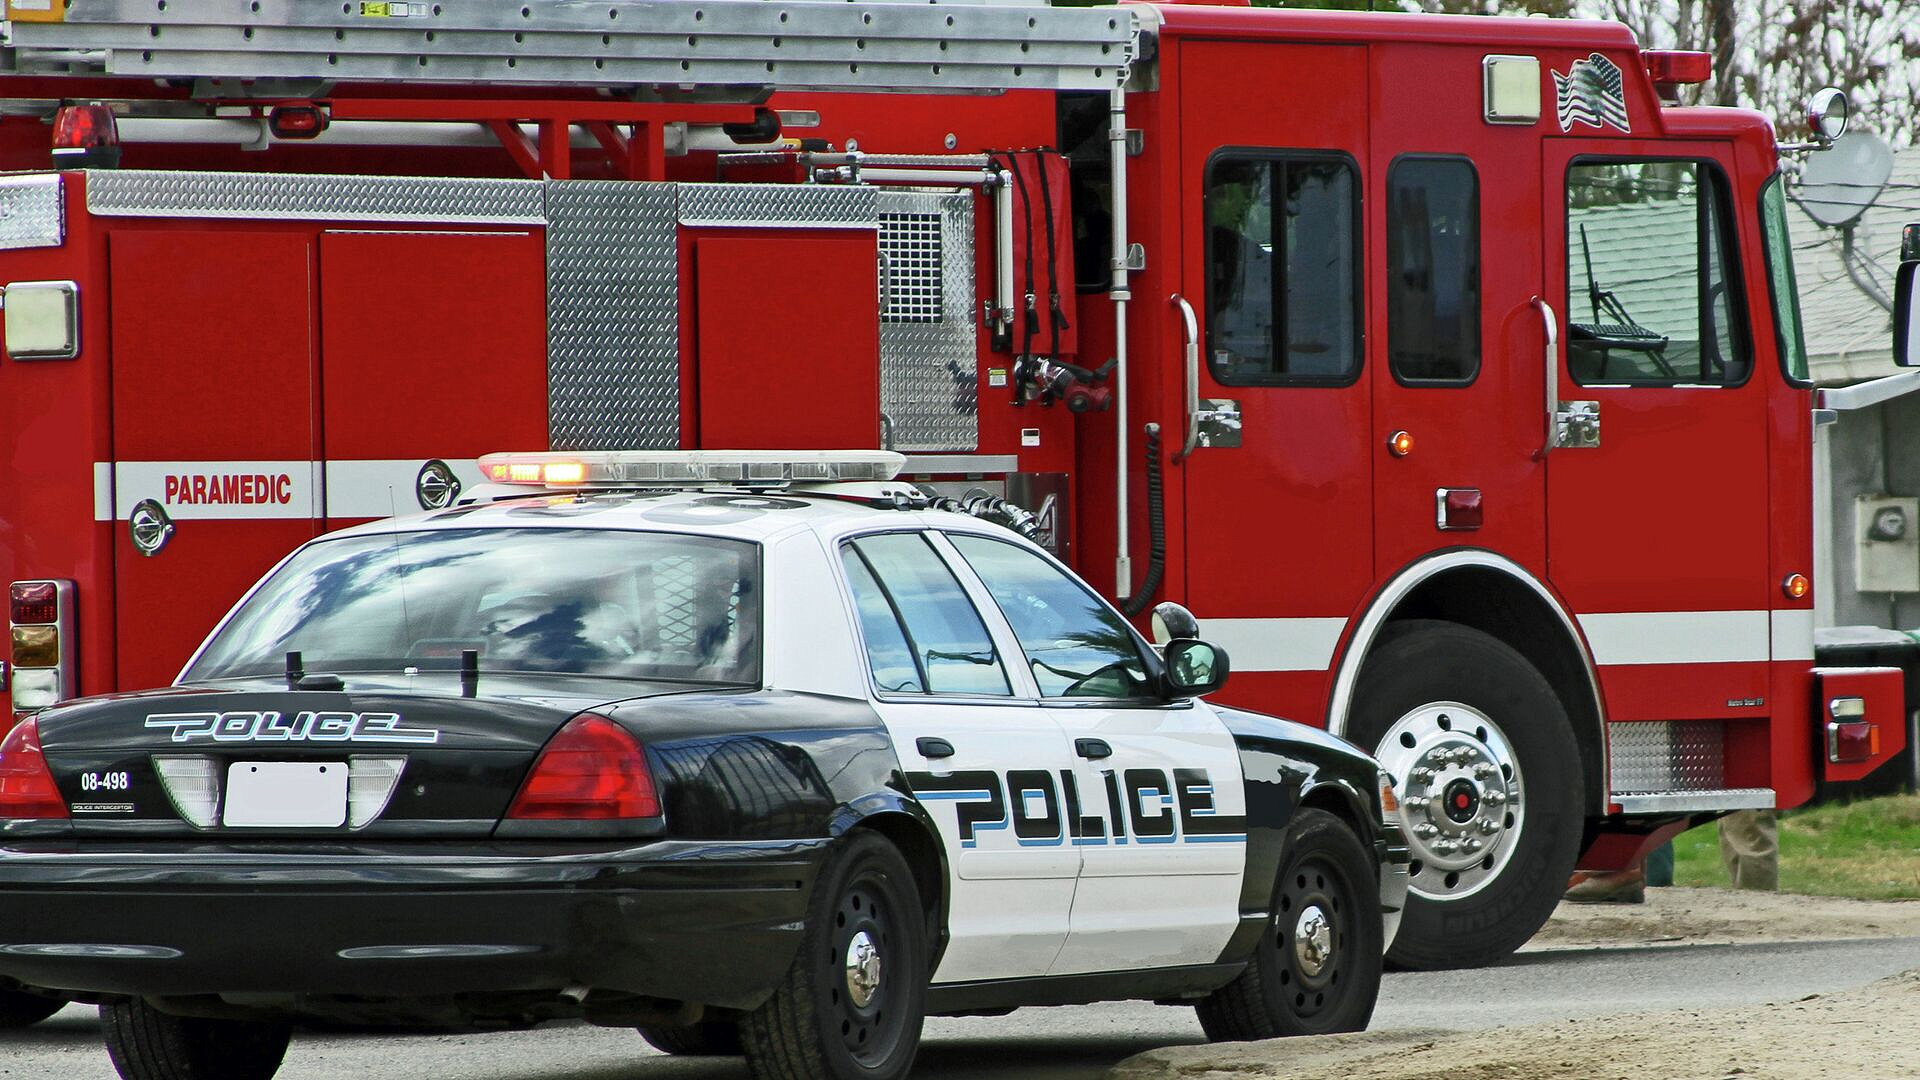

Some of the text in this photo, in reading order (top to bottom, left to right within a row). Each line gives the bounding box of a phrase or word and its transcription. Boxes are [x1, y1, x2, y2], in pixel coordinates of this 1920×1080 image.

[165, 474, 291, 505] PARAMEDIC
[145, 711, 438, 743] POLICE
[81, 771, 128, 791] 08-498
[904, 768, 1247, 848] POLICE
